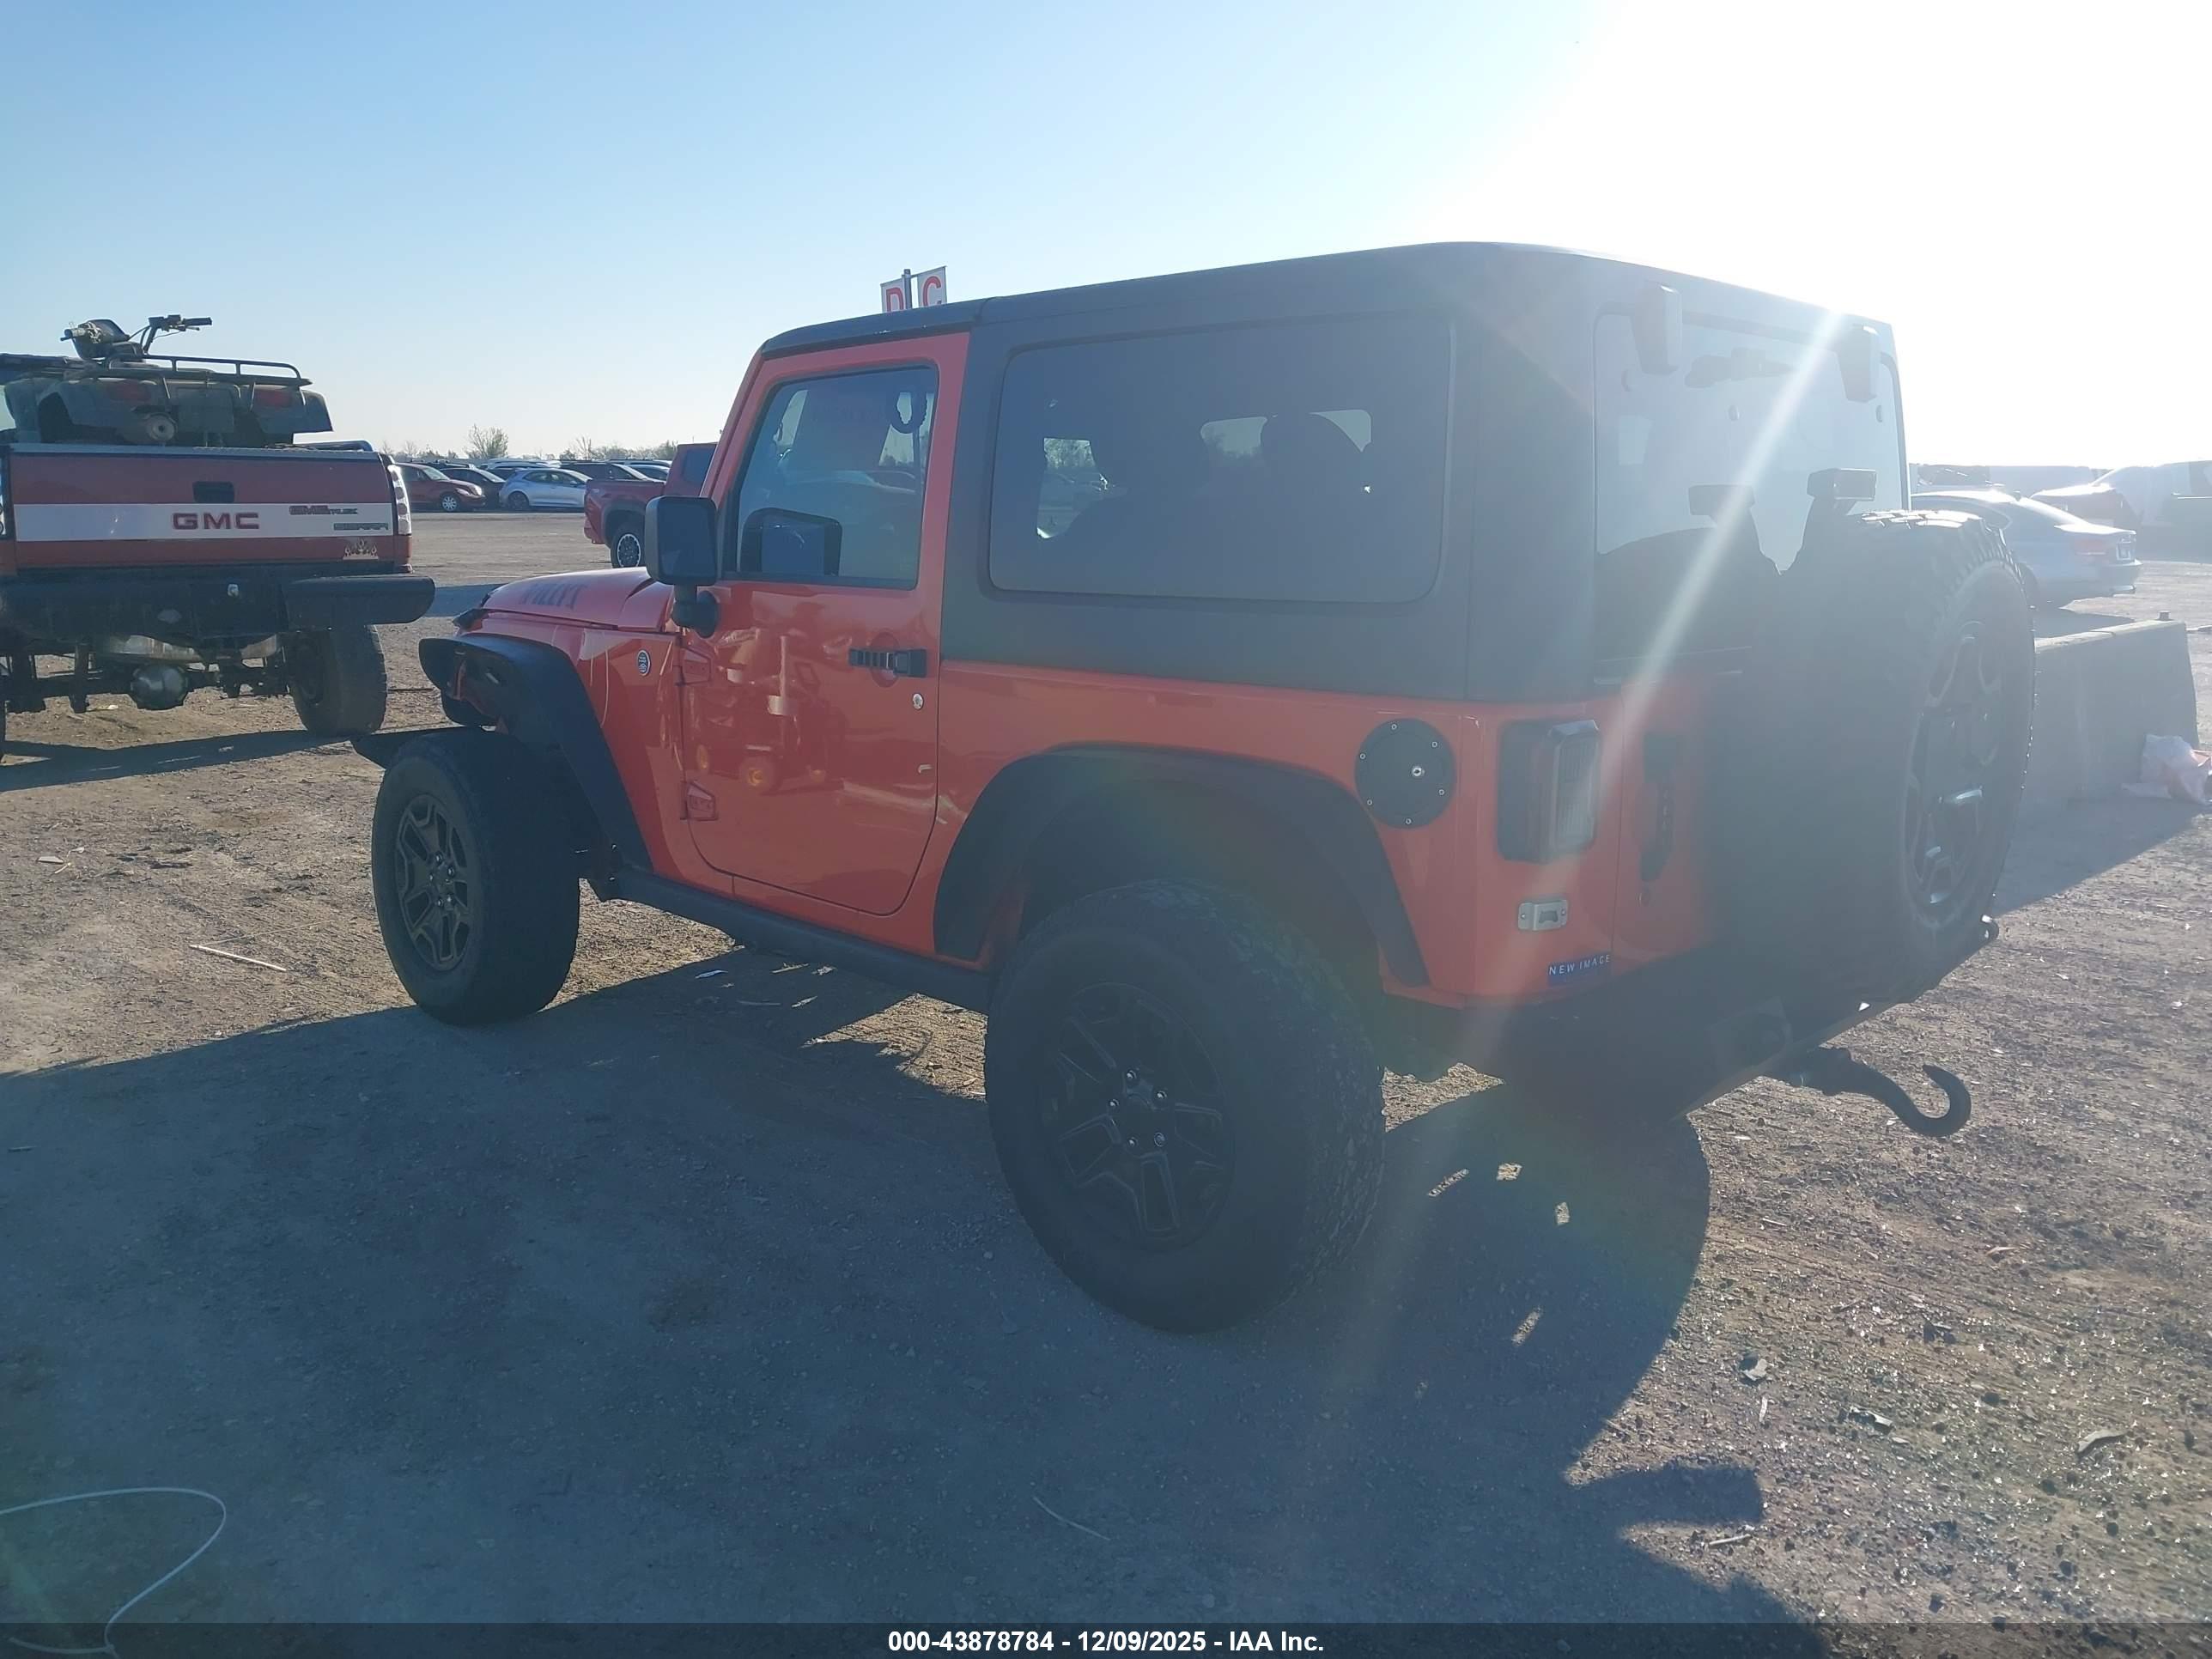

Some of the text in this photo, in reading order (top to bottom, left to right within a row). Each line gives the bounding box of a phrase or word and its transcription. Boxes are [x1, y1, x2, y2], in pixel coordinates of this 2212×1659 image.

[173, 513, 259, 530] GMC
[1548, 954, 1611, 975] NEW IMAGE
